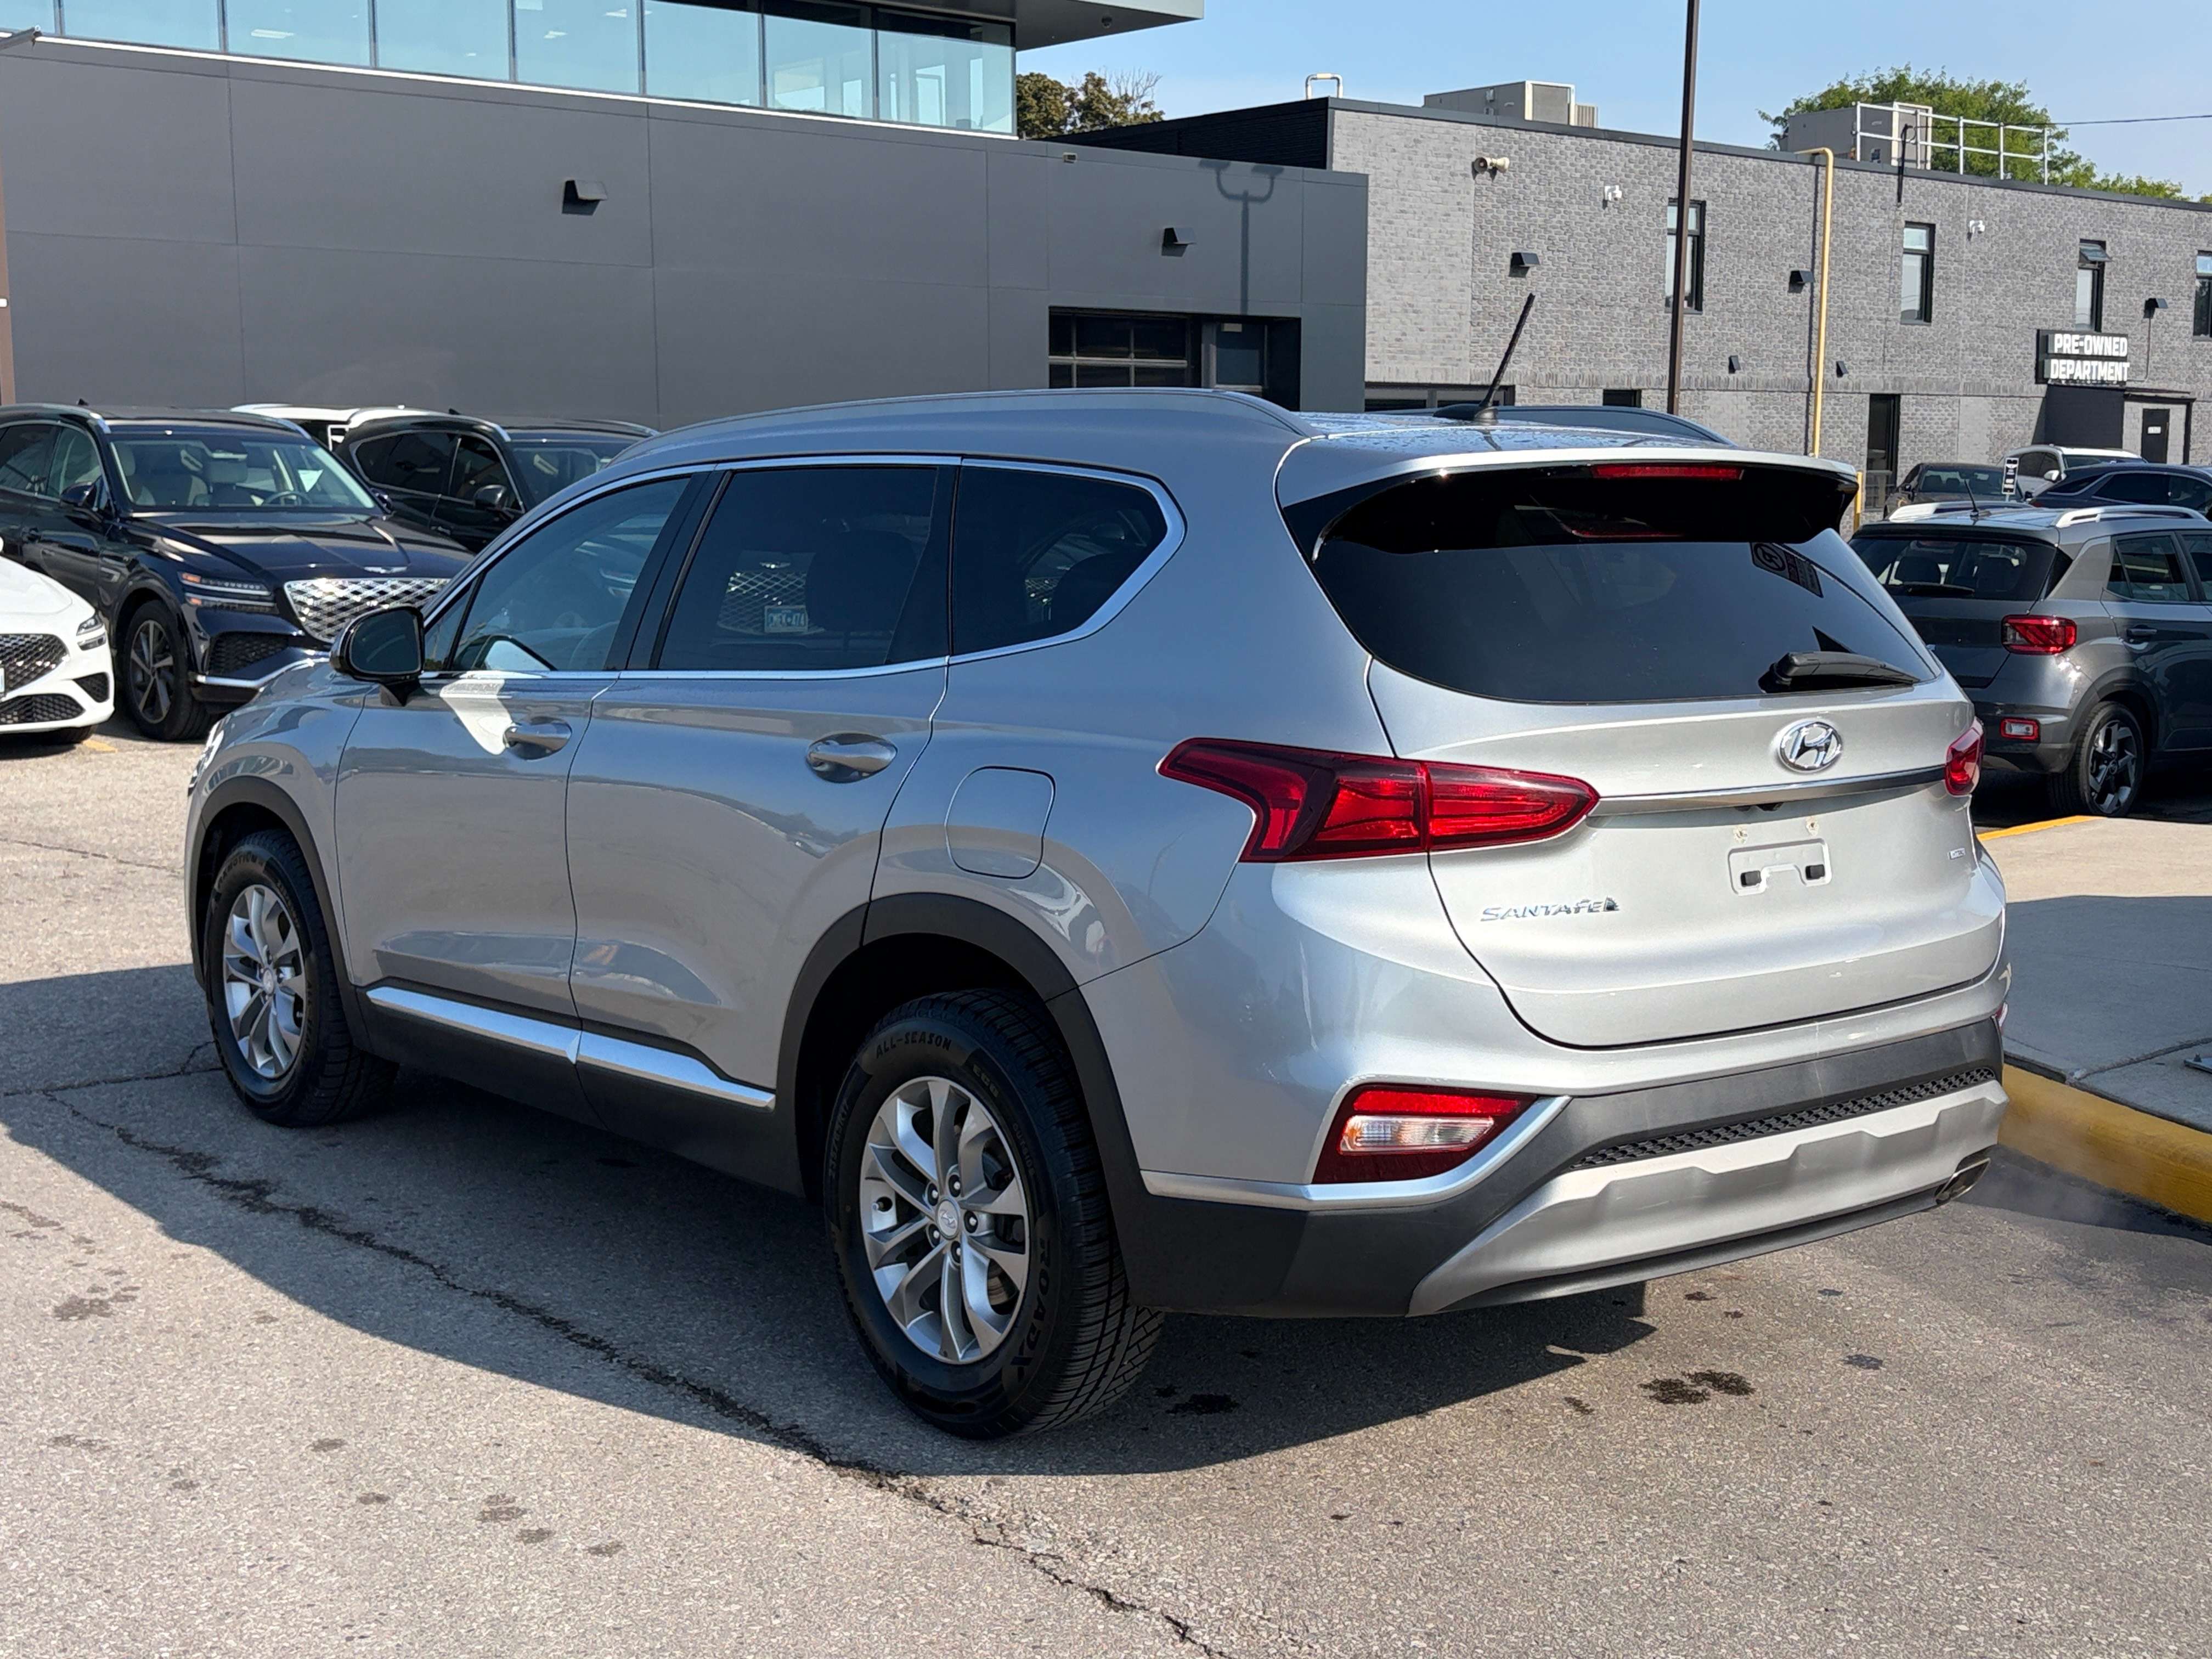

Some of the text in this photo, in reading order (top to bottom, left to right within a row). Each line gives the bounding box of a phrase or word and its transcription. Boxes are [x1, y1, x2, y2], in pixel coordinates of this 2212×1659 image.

[2054, 333, 2128, 357] PRE-OWNED
[2050, 358, 2130, 381] DEPARTMENT
[875, 1030, 953, 1059] ALL-SEASON
